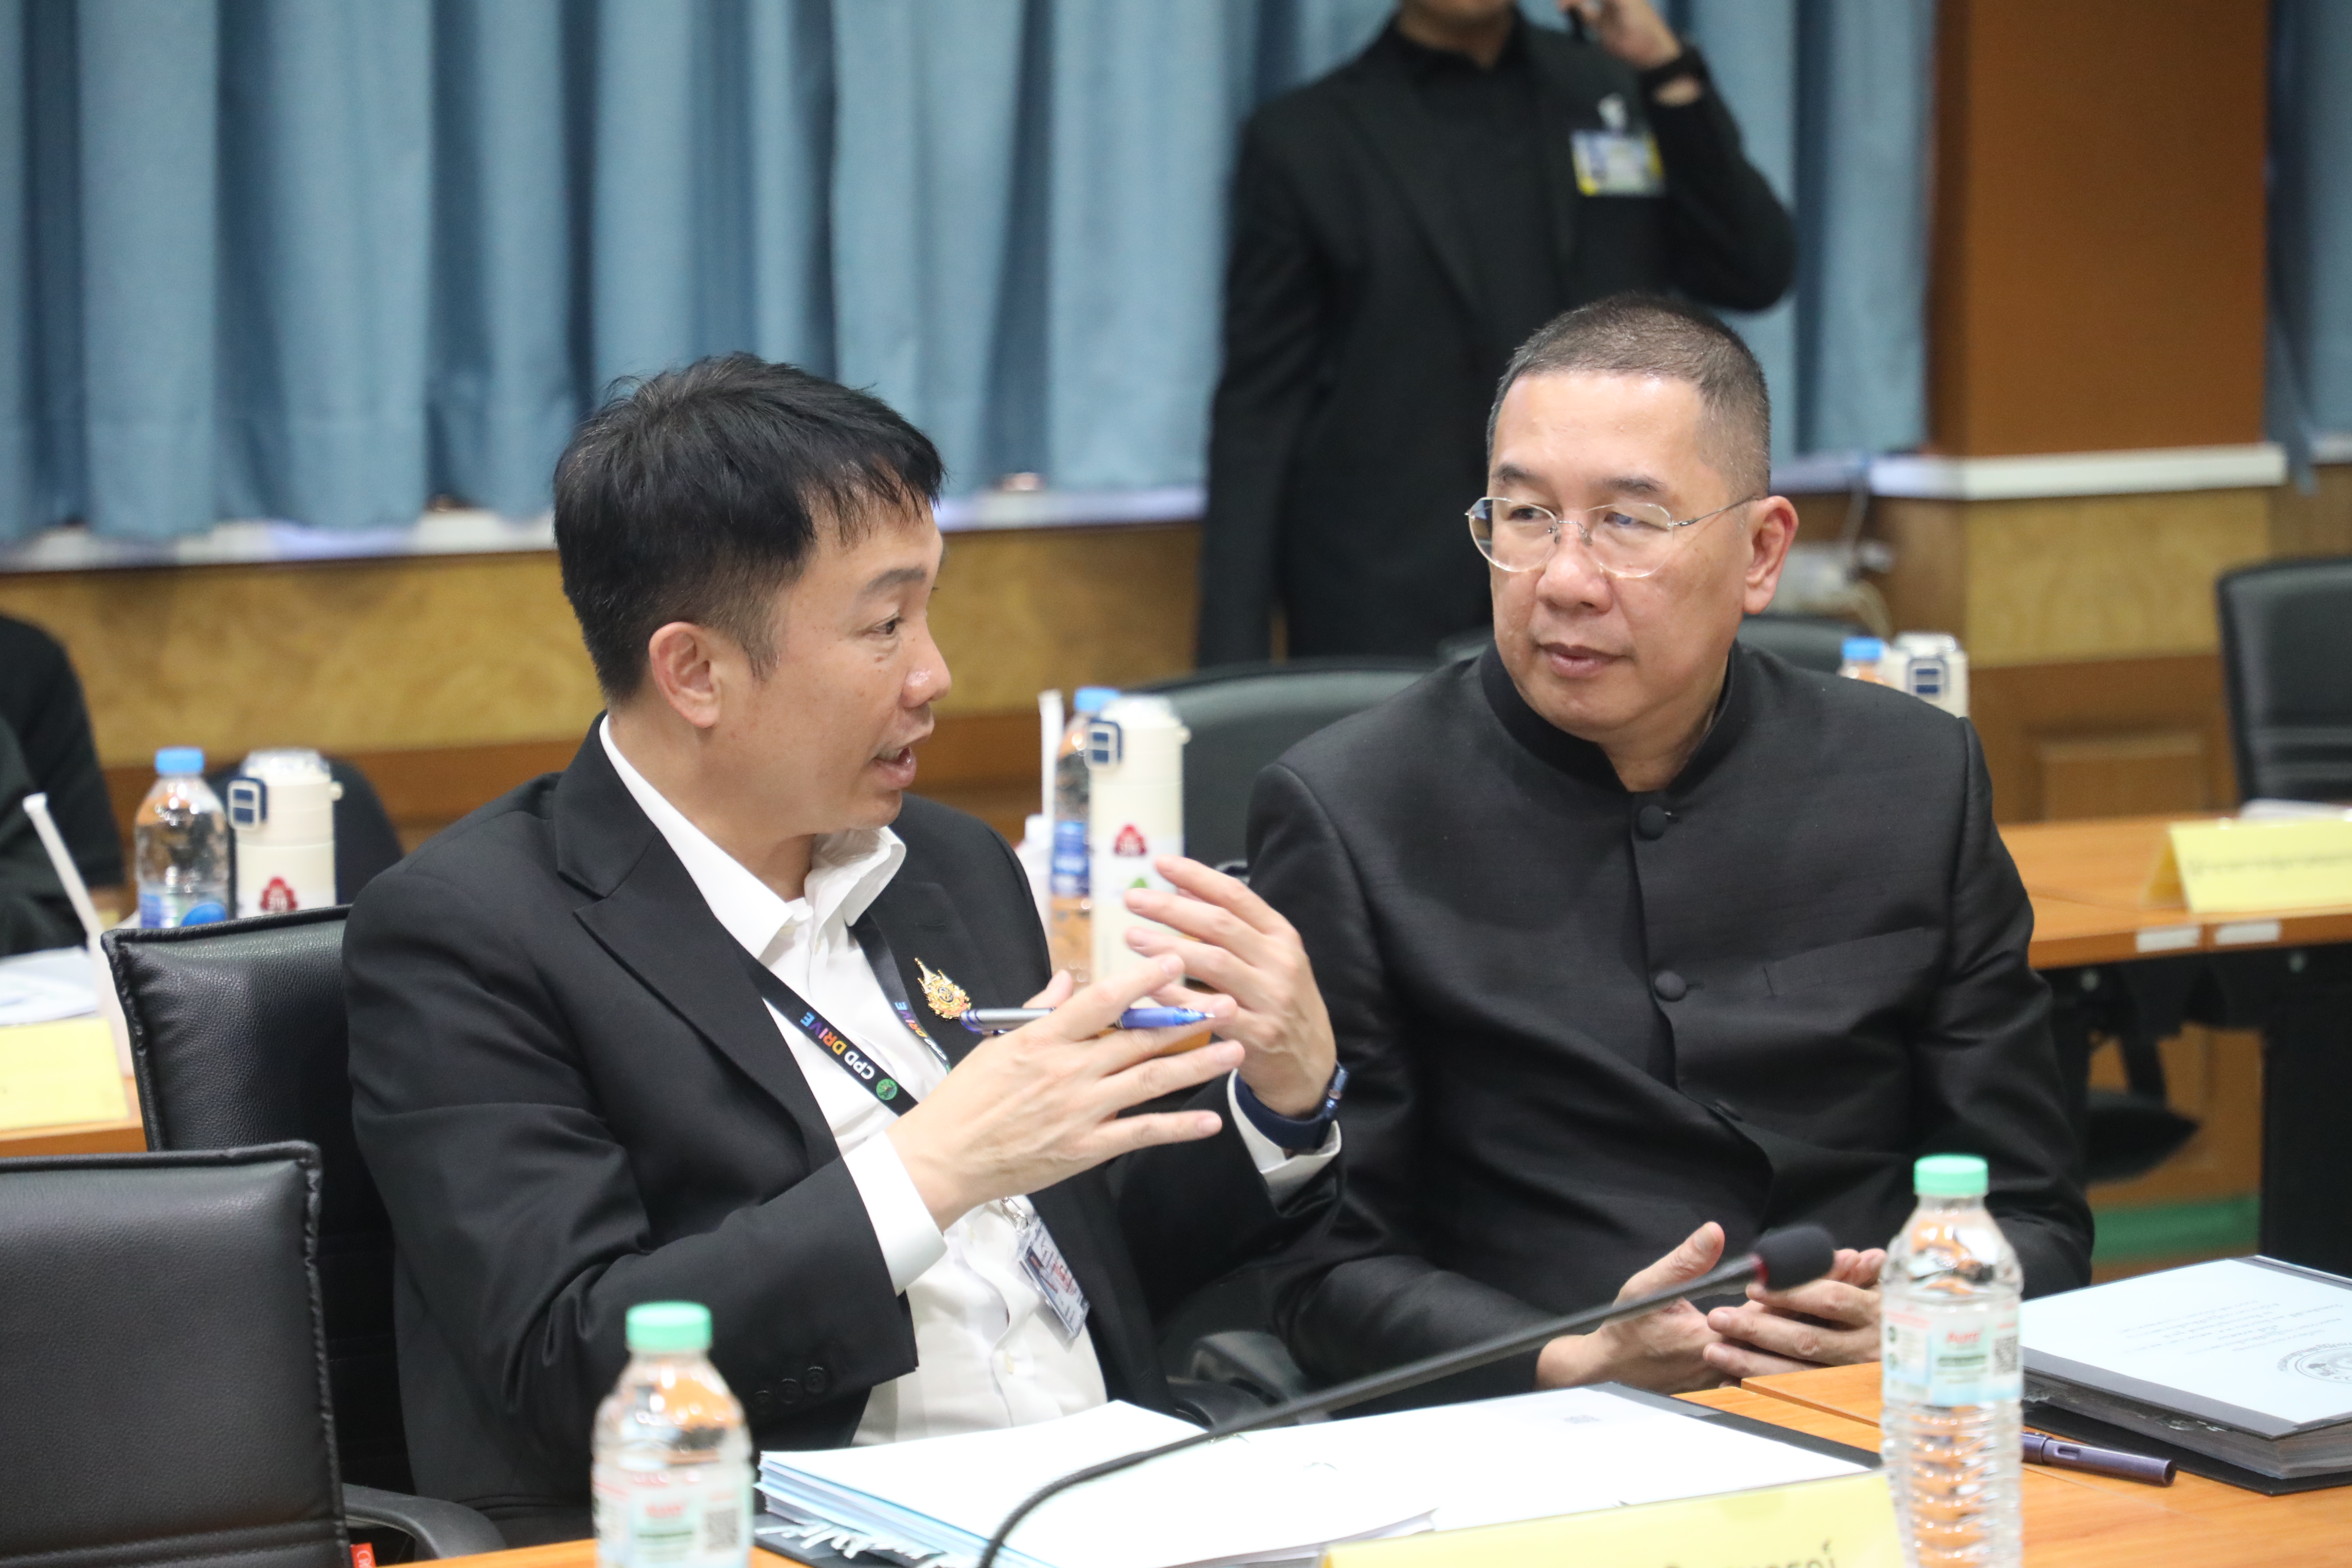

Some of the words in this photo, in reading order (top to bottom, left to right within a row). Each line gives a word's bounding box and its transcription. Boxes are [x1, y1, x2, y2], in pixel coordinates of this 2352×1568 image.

[800, 1012, 847, 1055] DRIVE
[895, 1002, 928, 1037] DRIVE
[844, 1051, 875, 1080] CPD
